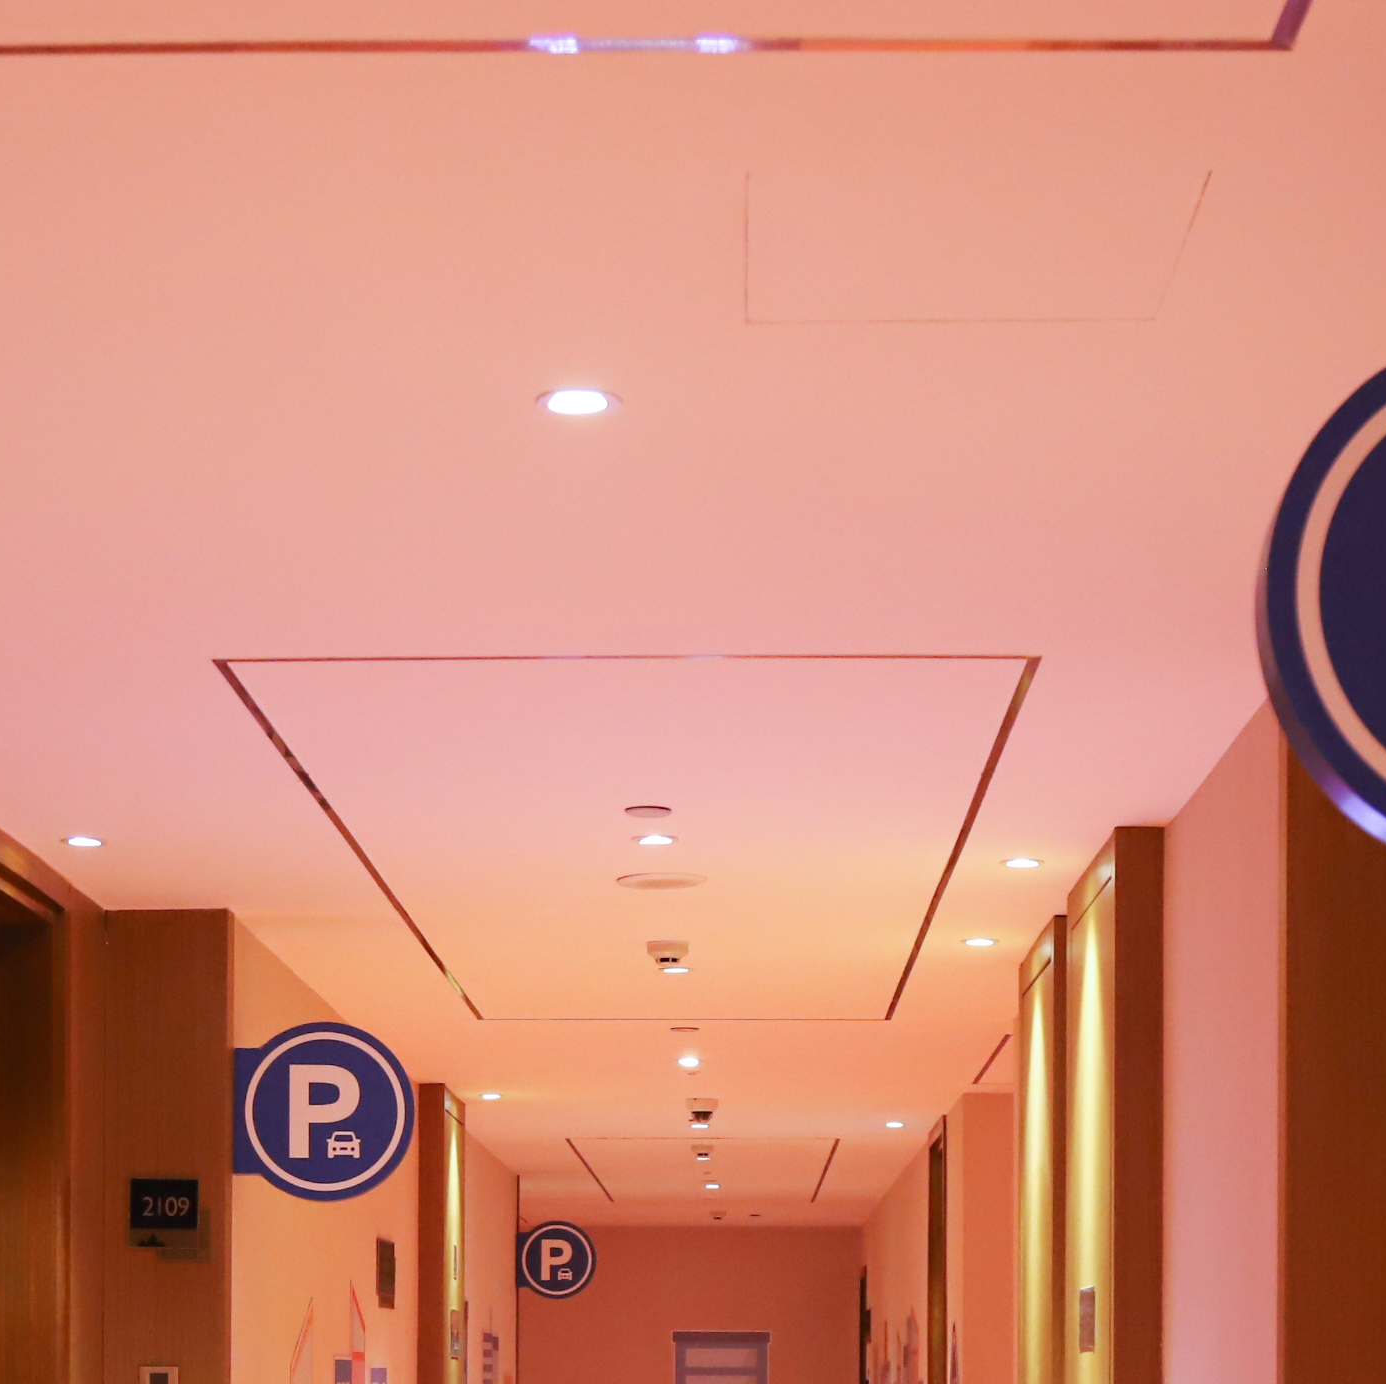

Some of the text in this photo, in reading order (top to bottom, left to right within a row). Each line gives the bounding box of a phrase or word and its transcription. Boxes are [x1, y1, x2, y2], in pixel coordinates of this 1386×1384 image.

[288, 1063, 361, 1159] P
[142, 1196, 190, 1217] 2109
[540, 1238, 573, 1281] P
